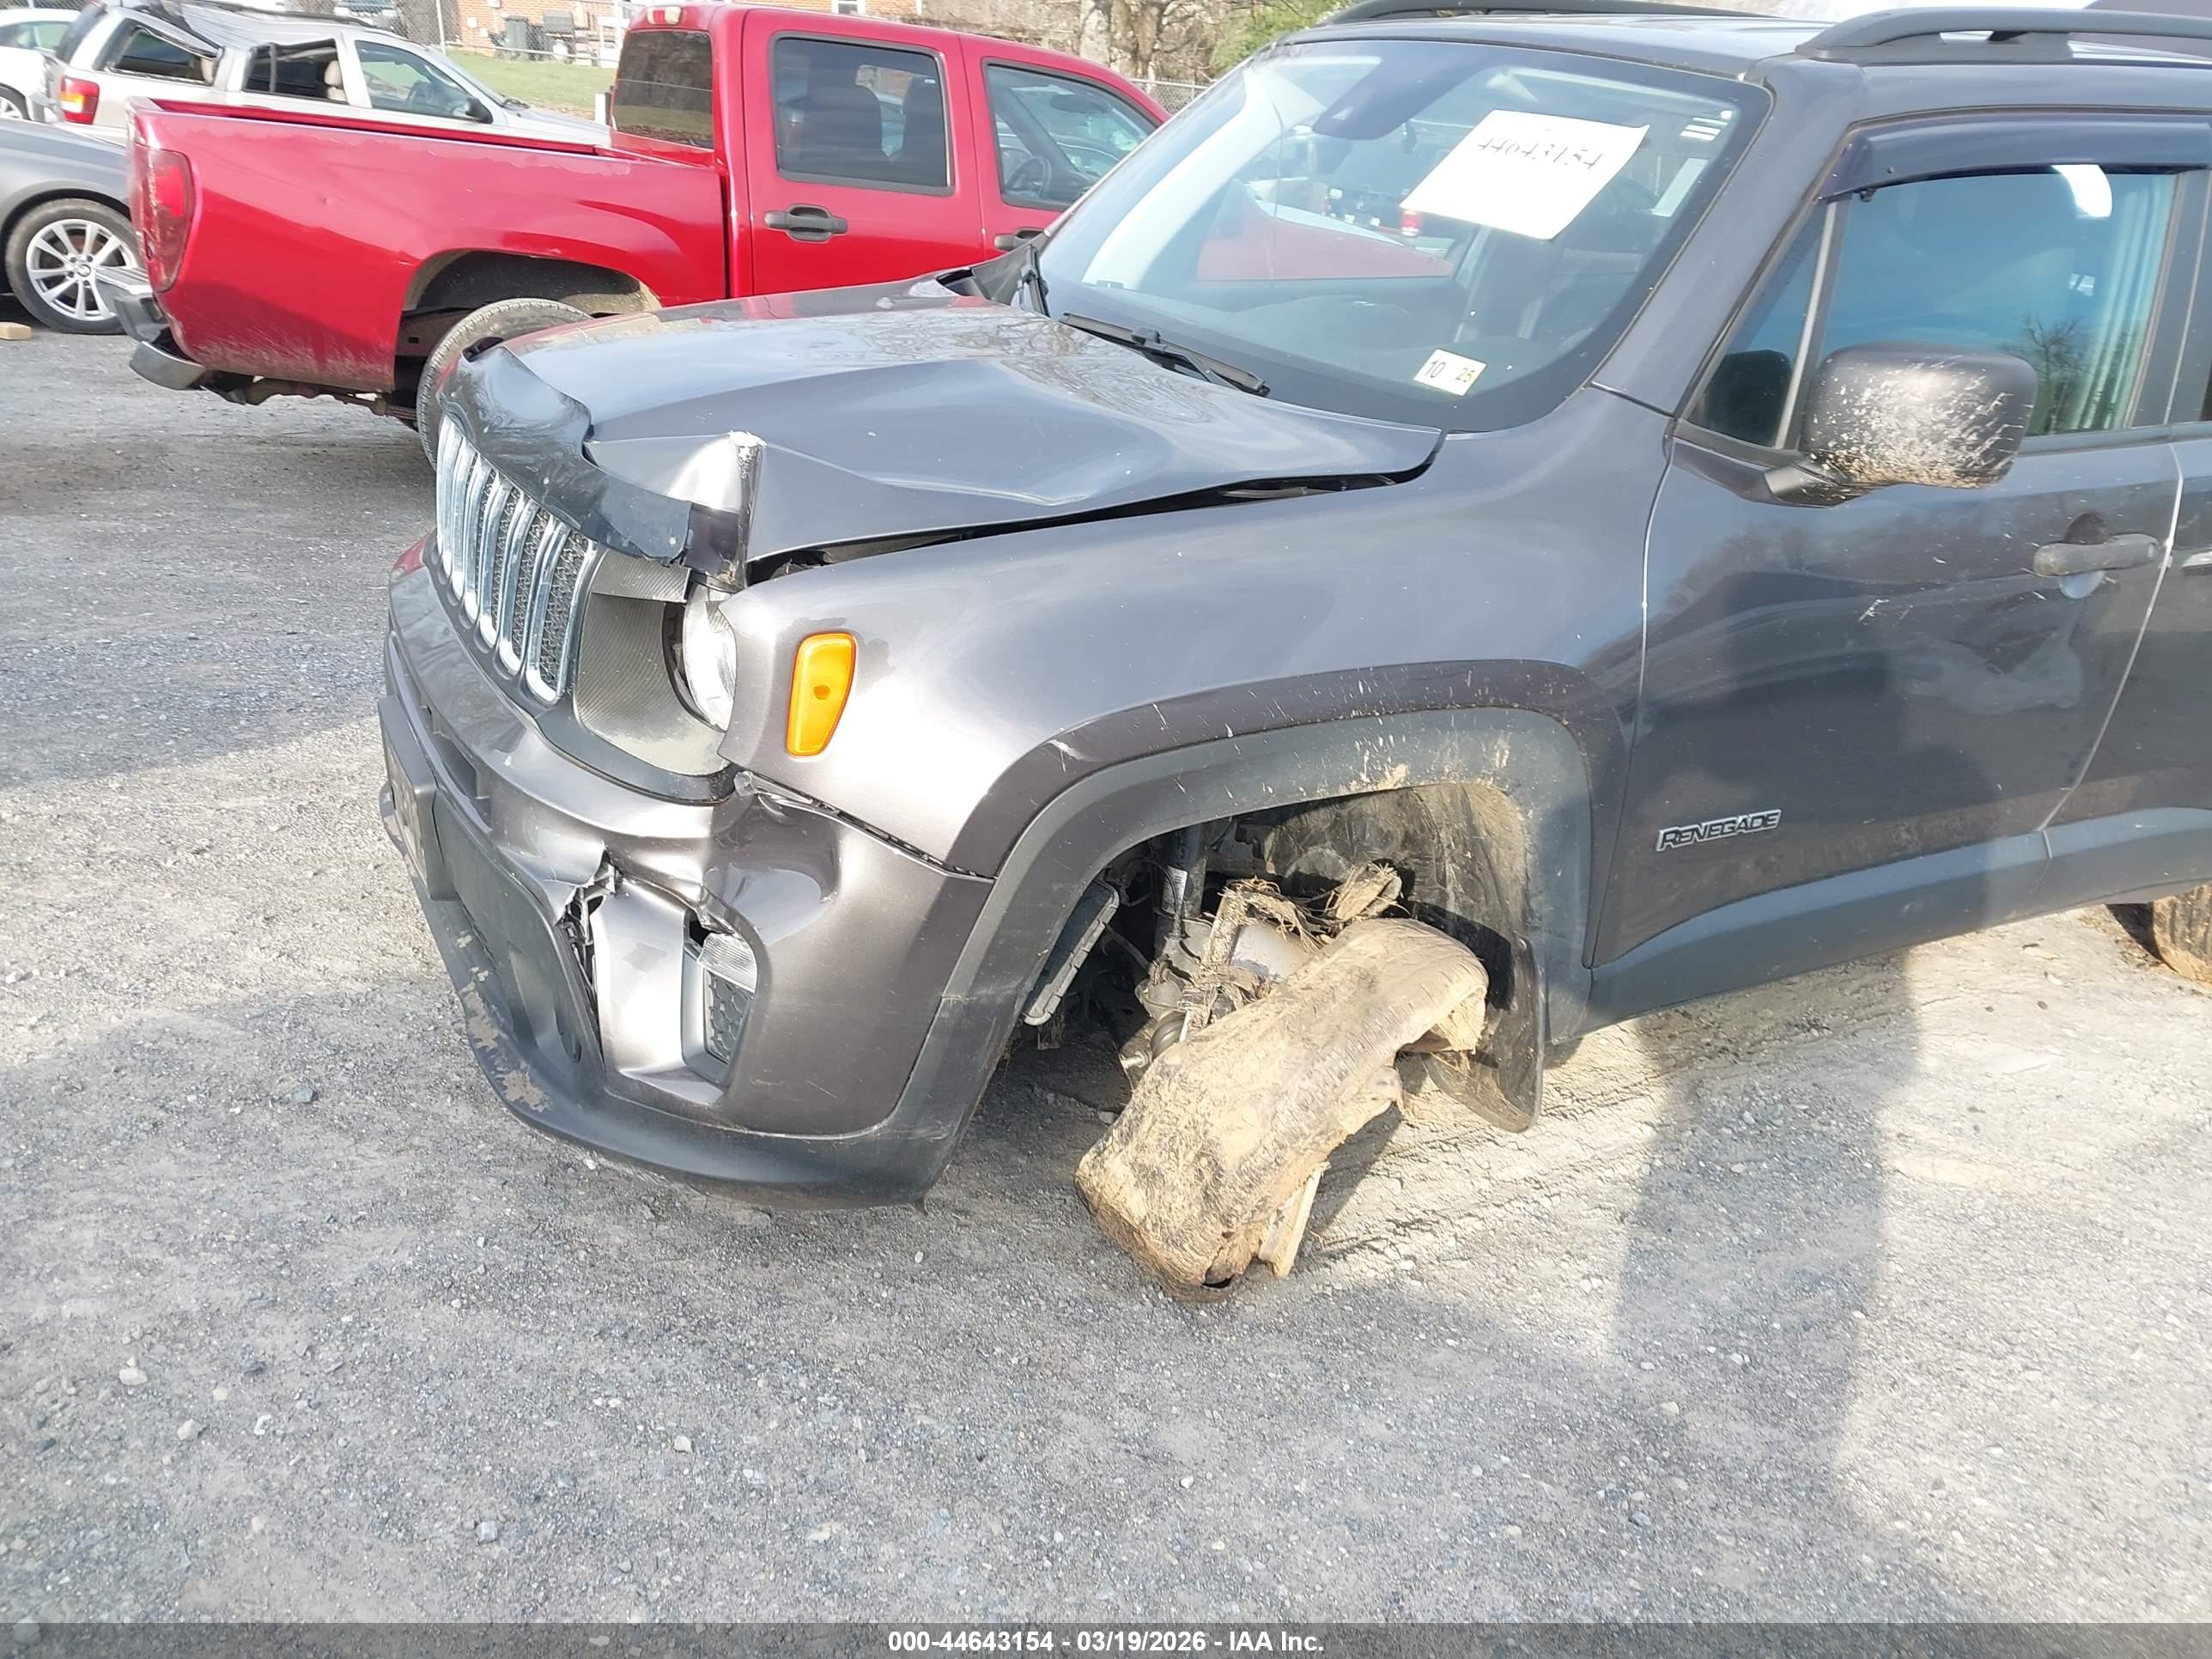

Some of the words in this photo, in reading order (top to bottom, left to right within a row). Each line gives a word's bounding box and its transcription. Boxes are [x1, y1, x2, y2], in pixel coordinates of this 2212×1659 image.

[1425, 358, 1446, 379] 10
[1455, 368, 1476, 383] 25
[1656, 809, 1782, 852] RENEGADE
